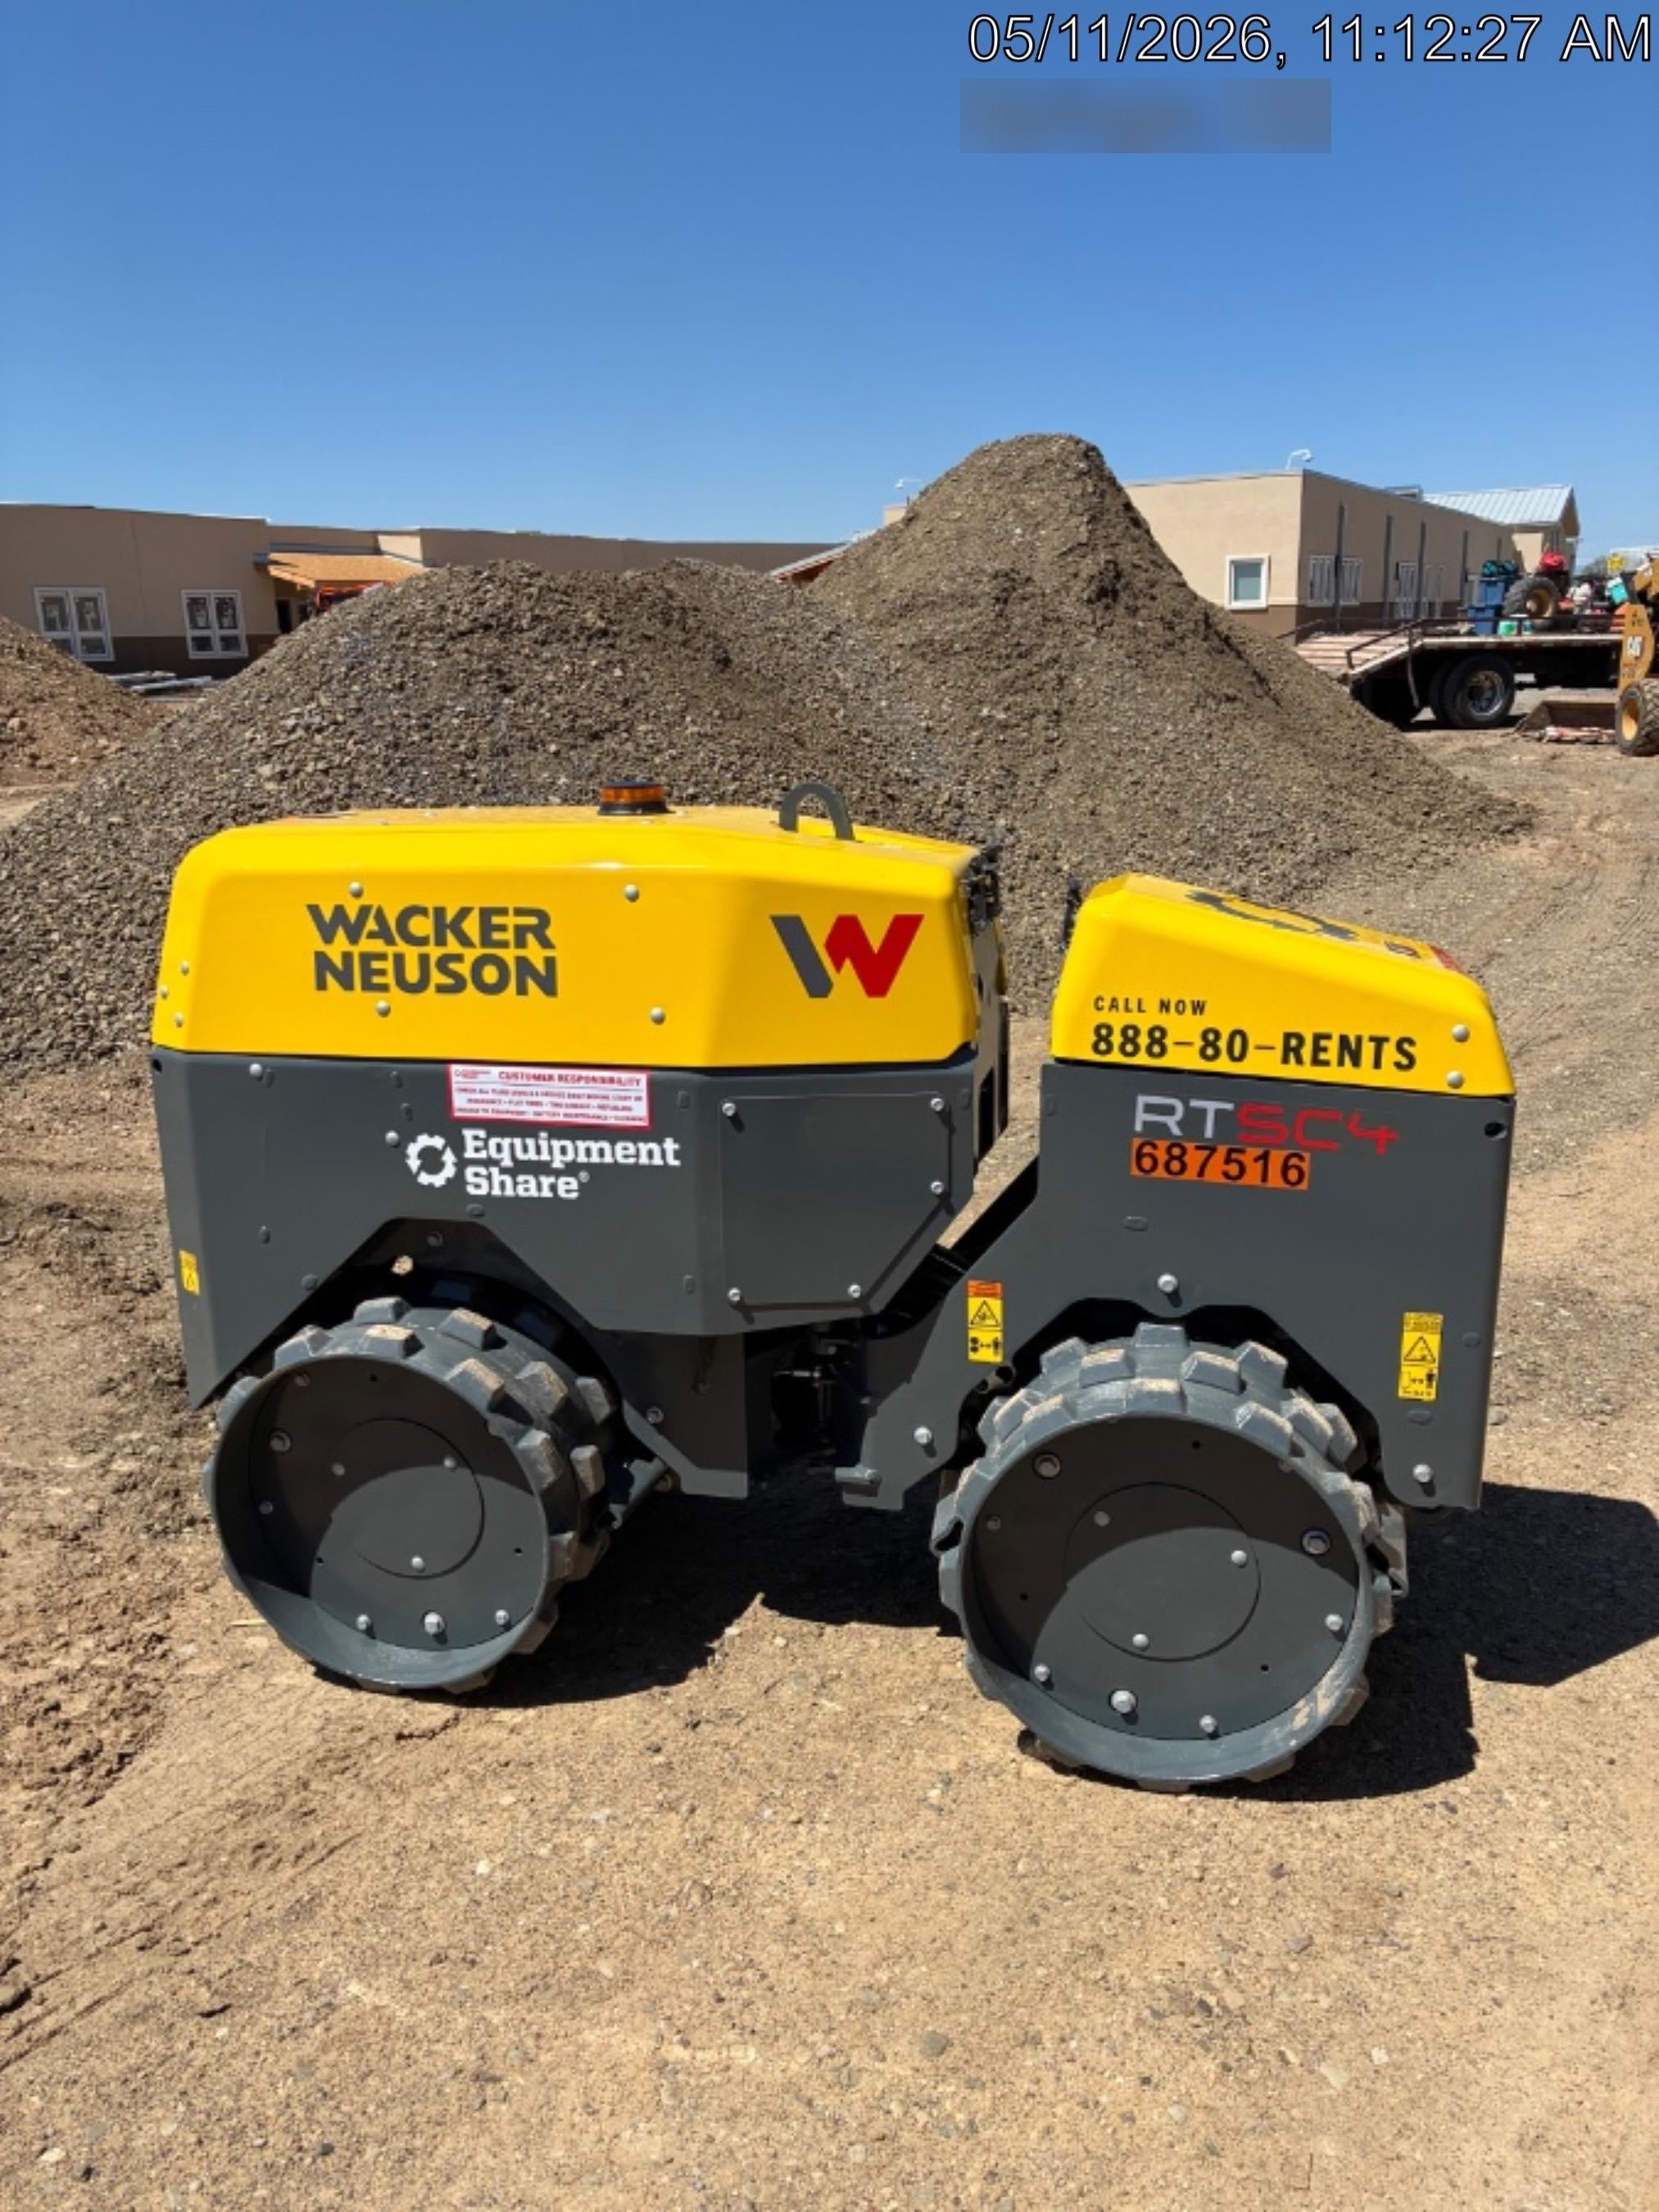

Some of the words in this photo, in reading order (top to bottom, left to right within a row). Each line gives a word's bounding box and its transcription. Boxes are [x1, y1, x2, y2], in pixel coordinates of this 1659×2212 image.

[306, 904, 556, 950] WACKER
[314, 951, 558, 997] NEUSON
[1094, 995, 1146, 1013] CALL
[1159, 999, 1207, 1016] NOW
[1091, 1022, 1417, 1072] 888-80-RENTS
[461, 1128, 682, 1169] Equipment
[1135, 1142, 1307, 1186] 687516
